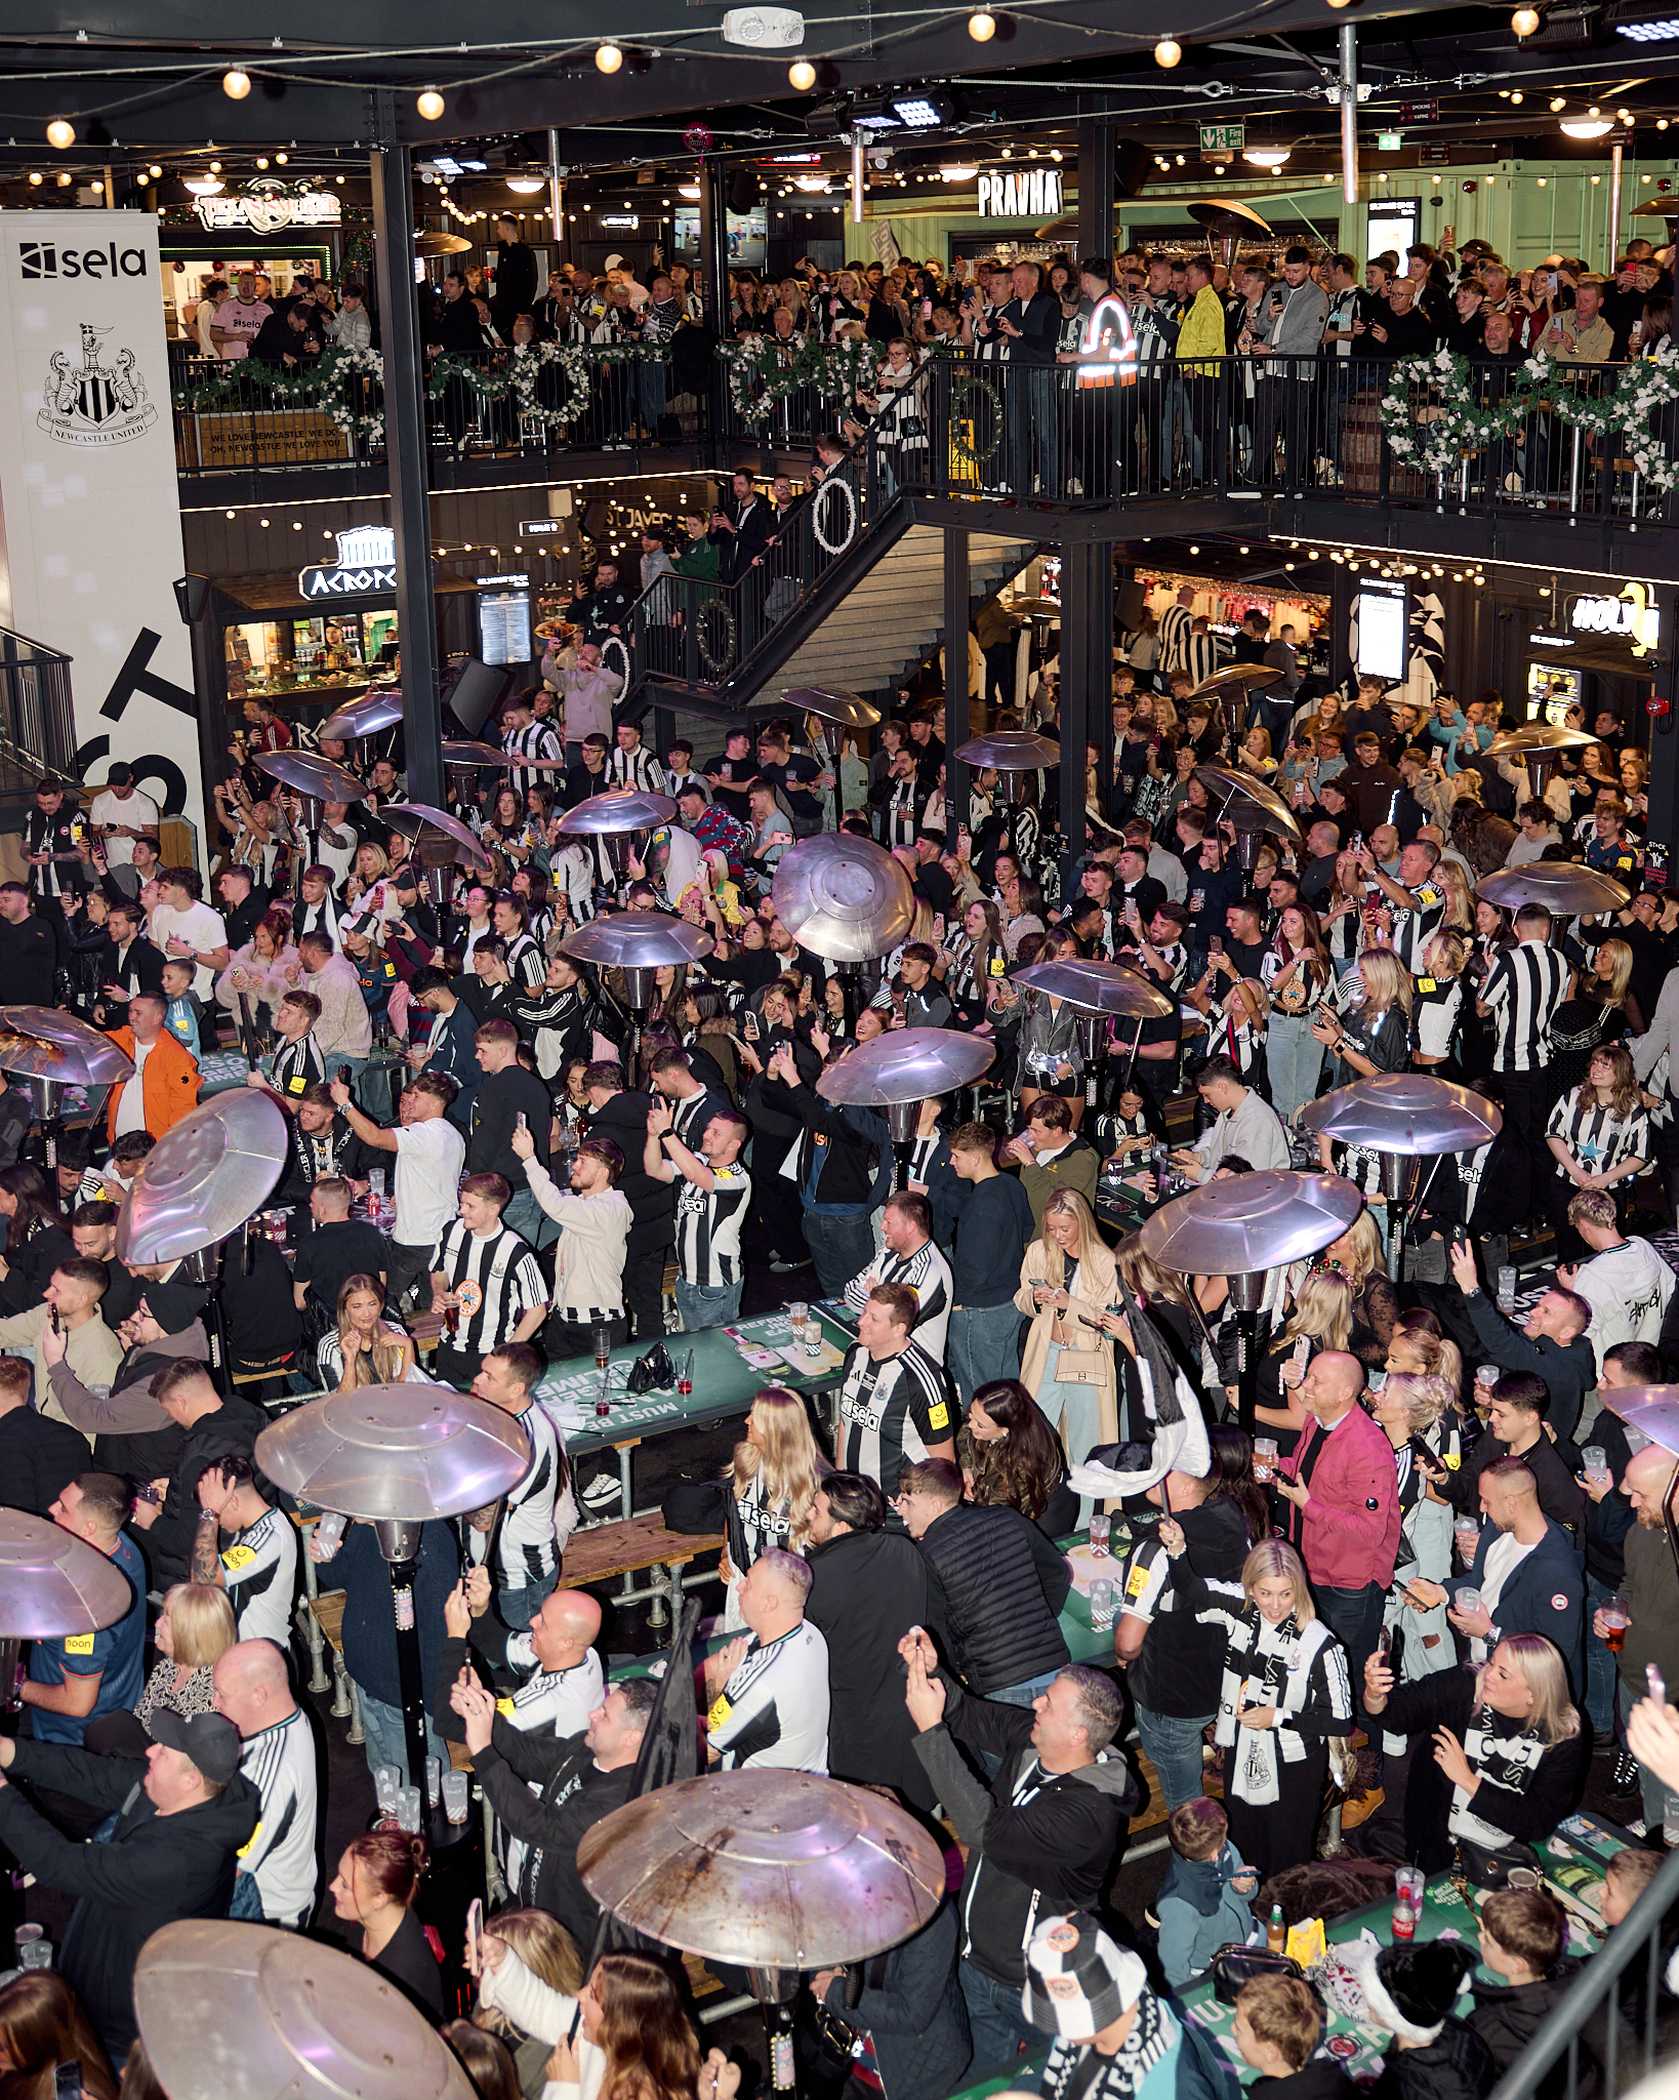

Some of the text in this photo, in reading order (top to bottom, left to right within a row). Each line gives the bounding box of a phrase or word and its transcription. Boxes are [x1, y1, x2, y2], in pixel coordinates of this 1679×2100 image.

[1229, 128, 1241, 137] Fire
[1229, 138, 1242, 147] exit
[978, 171, 1060, 217] PRAVHA
[61, 241, 147, 280] sela
[241, 319, 261, 329] sela
[54, 425, 145, 443] NEWCASTLE UNITED
[620, 1402, 680, 1424] MUST
[851, 1403, 880, 1432] sela
[586, 1417, 615, 1432] BE
[751, 1506, 791, 1535] sela
